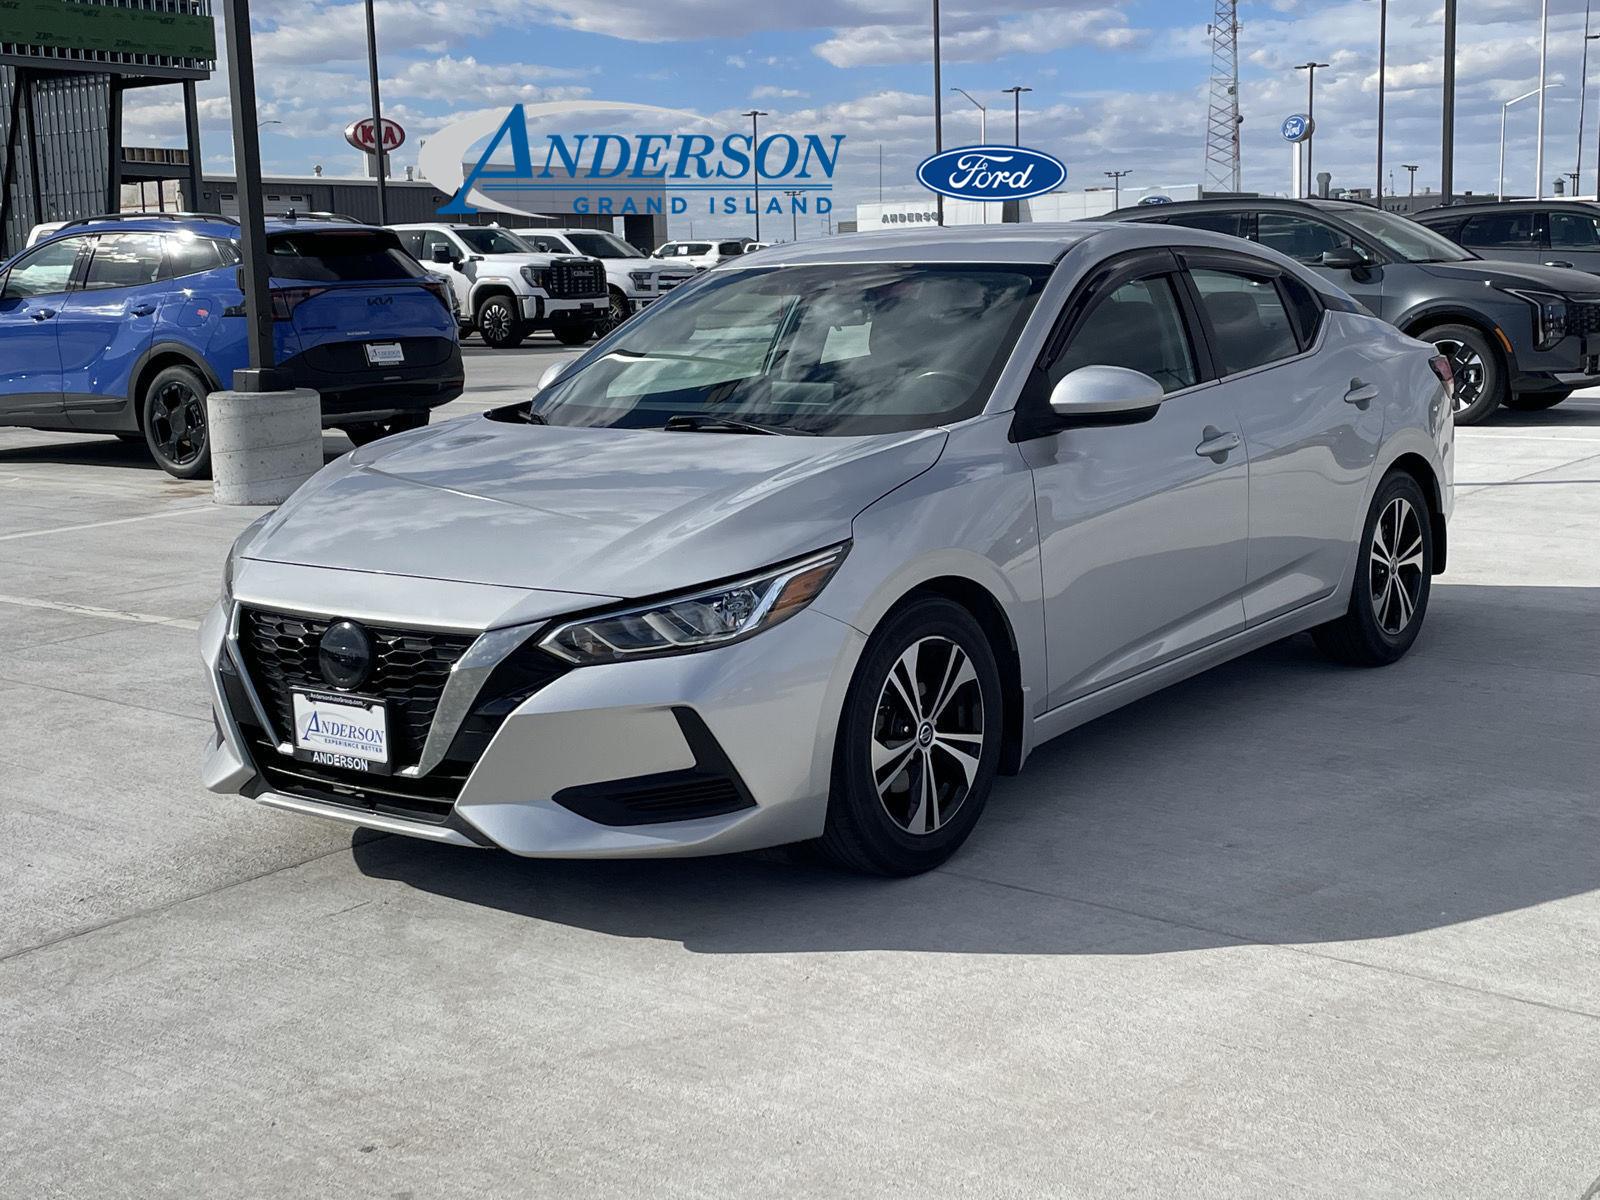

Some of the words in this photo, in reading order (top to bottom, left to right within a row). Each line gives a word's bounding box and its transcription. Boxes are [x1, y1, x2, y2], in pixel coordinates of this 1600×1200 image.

[361, 125, 398, 145] KA
[881, 211, 943, 224] ANDERSO
[302, 711, 384, 743] ANDERSON
[313, 752, 368, 771] ANDERSON
